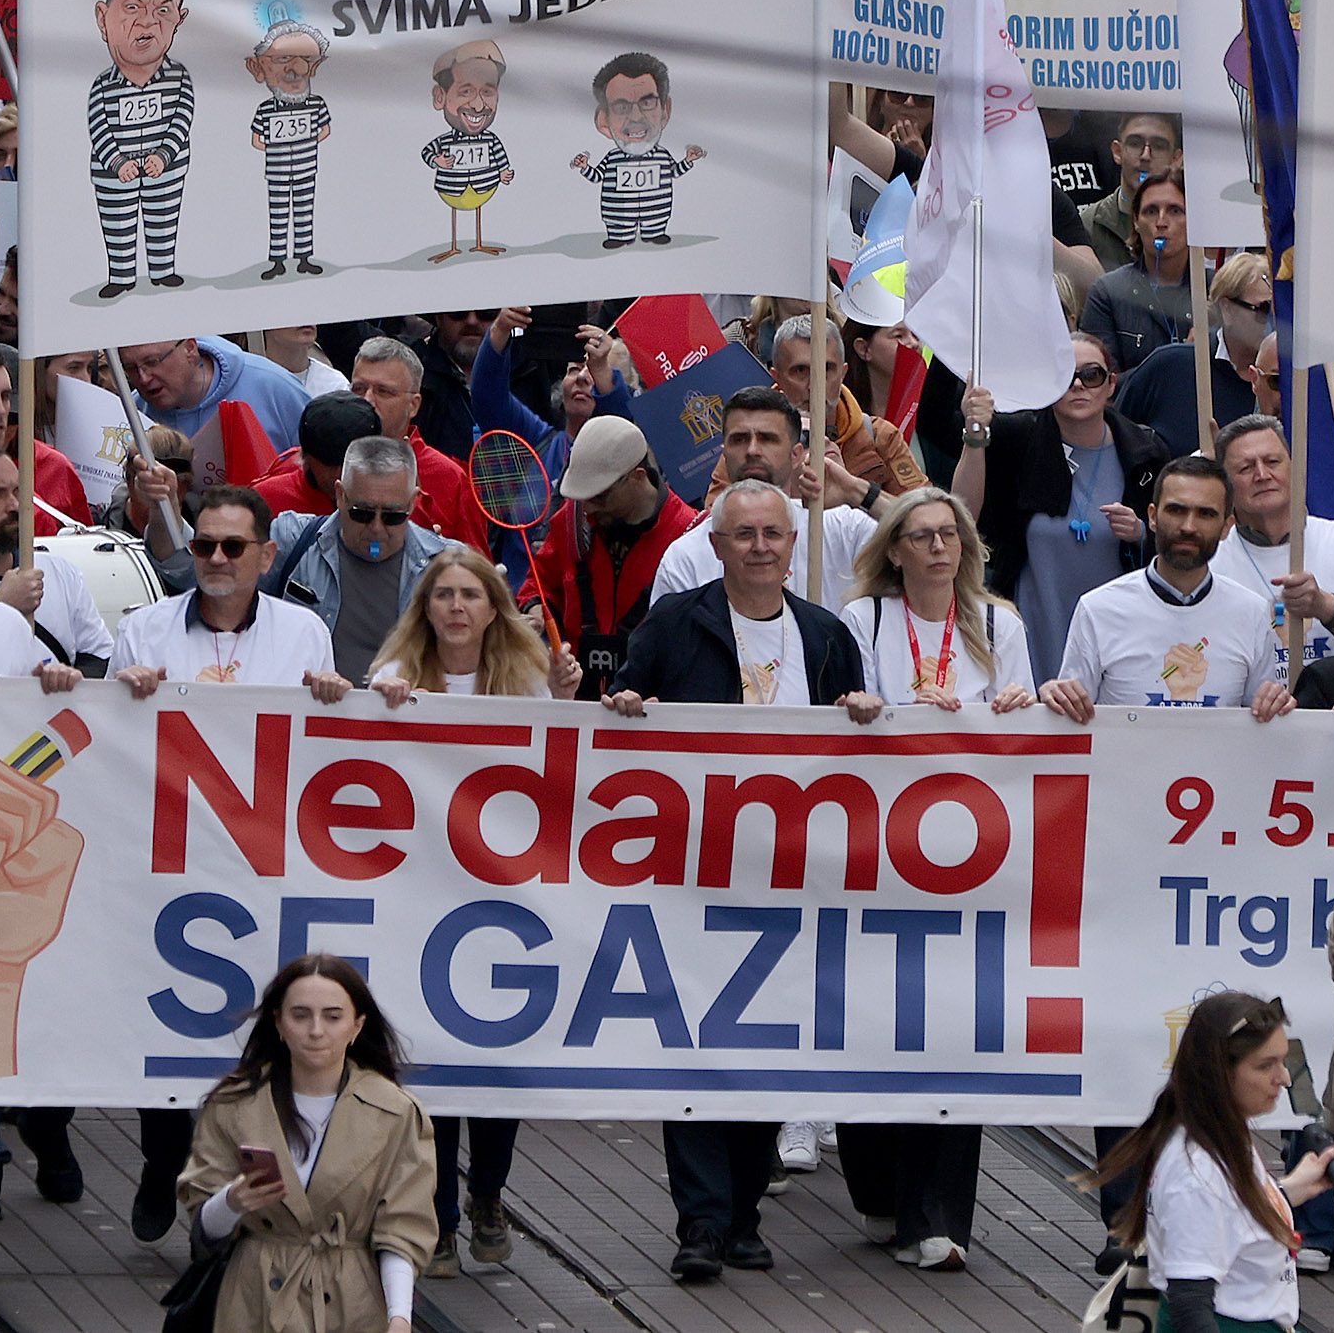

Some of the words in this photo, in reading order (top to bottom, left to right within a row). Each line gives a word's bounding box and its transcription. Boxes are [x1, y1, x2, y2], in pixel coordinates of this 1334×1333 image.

[832, 28, 890, 66] HOĆU
[1084, 17, 1099, 50] U
[124, 97, 160, 123] 2.55
[274, 116, 311, 141] 2.35
[455, 144, 486, 167] 2.17
[621, 168, 656, 189] 2.01
[151, 711, 417, 880] Ne
[1160, 876, 1290, 968] Trg
